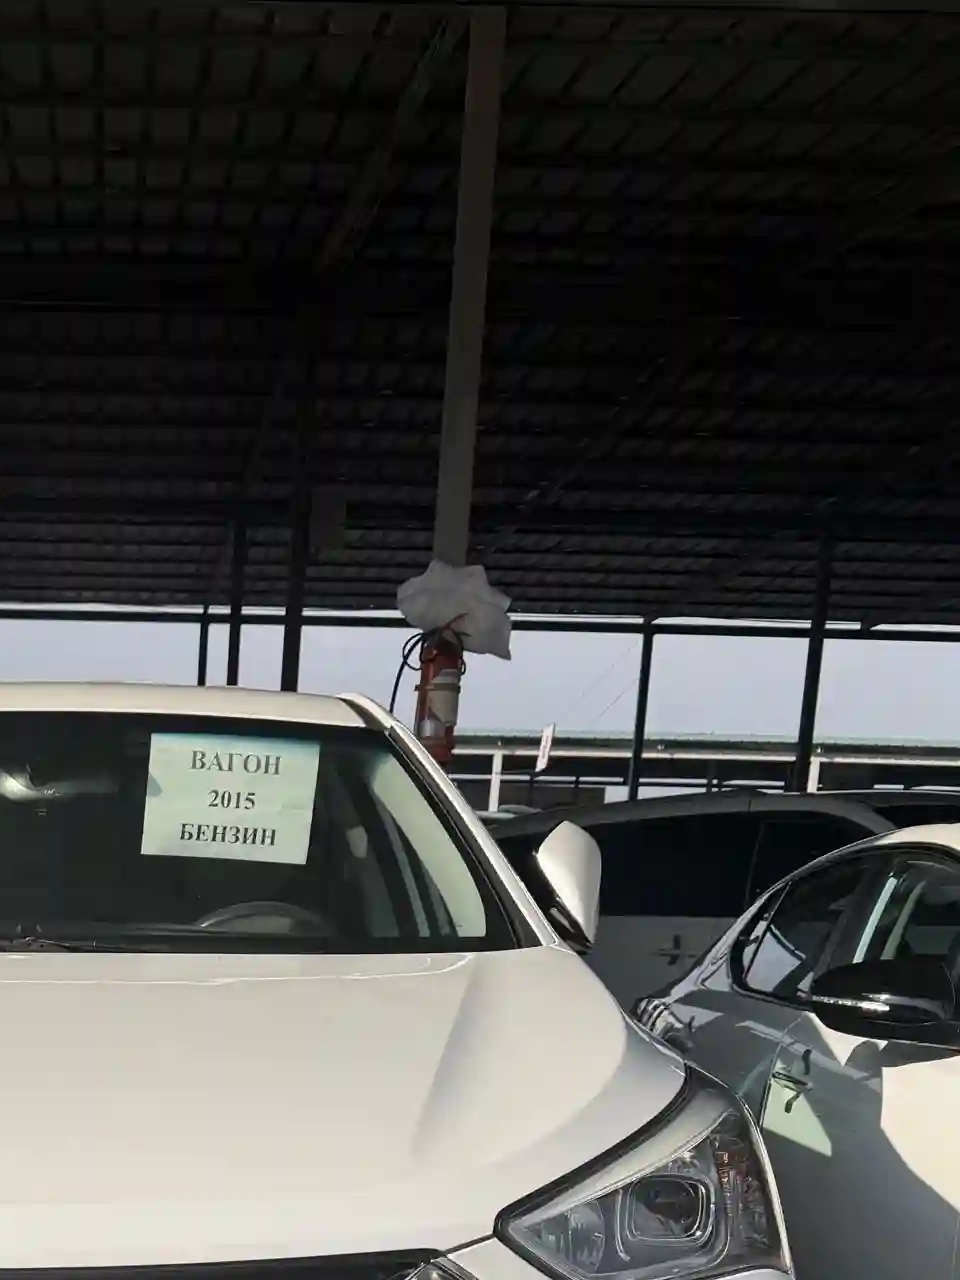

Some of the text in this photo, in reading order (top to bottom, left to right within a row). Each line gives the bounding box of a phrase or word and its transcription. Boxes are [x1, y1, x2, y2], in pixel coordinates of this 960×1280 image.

[190, 750, 282, 775] ВАГОН
[208, 789, 256, 809] 2015
[179, 823, 276, 845] БЕНЗИН
